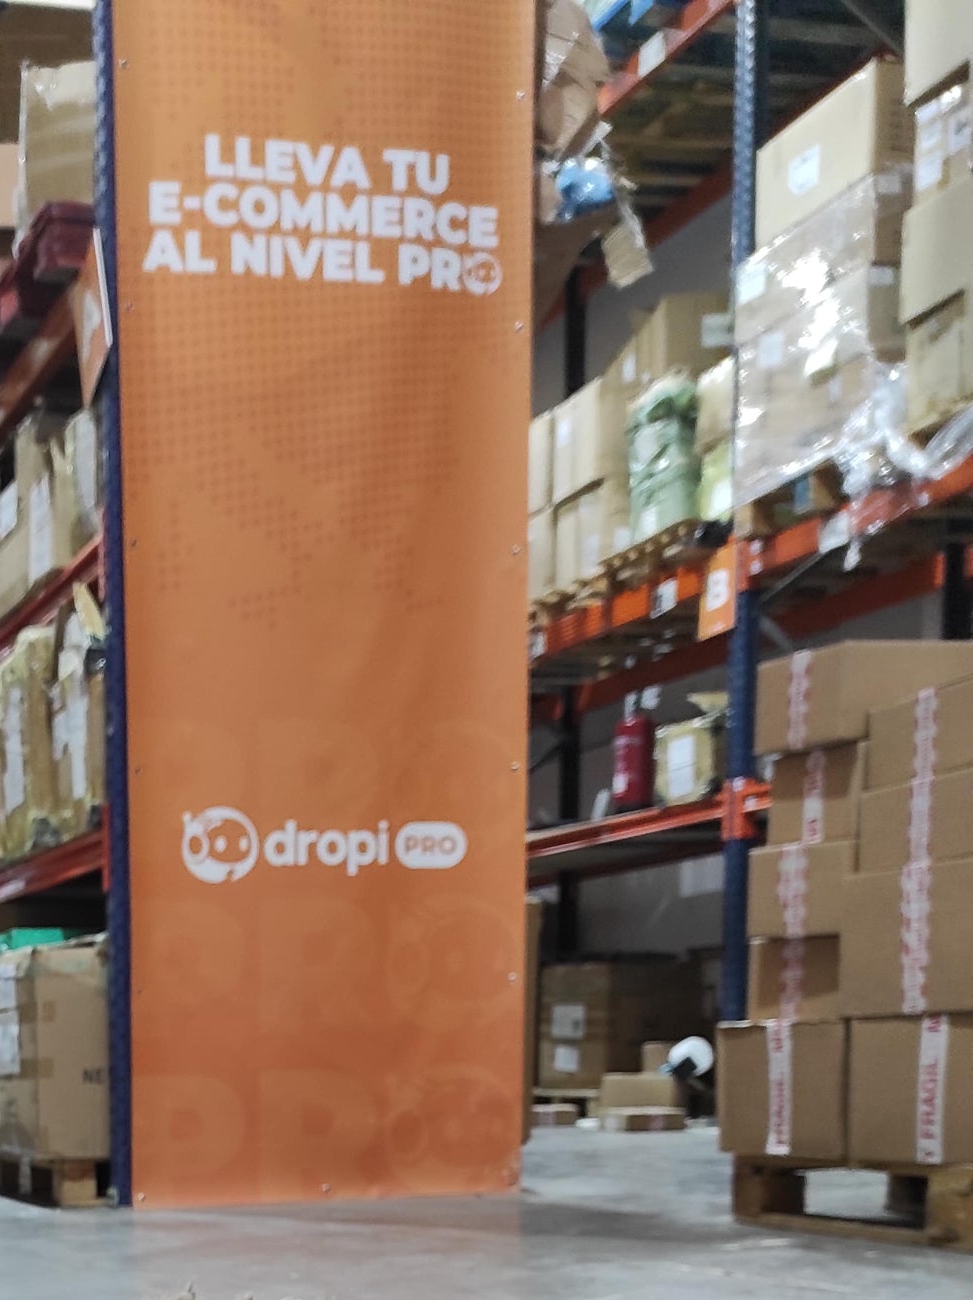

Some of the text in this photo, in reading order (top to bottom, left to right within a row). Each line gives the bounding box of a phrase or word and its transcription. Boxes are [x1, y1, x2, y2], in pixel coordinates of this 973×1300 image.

[204, 133, 450, 195] LLEVA TU
[148, 181, 500, 249] E-COMMERCE
[143, 230, 217, 274] AL
[230, 232, 385, 284] NIVEL
[263, 819, 458, 876] dropi PRO
